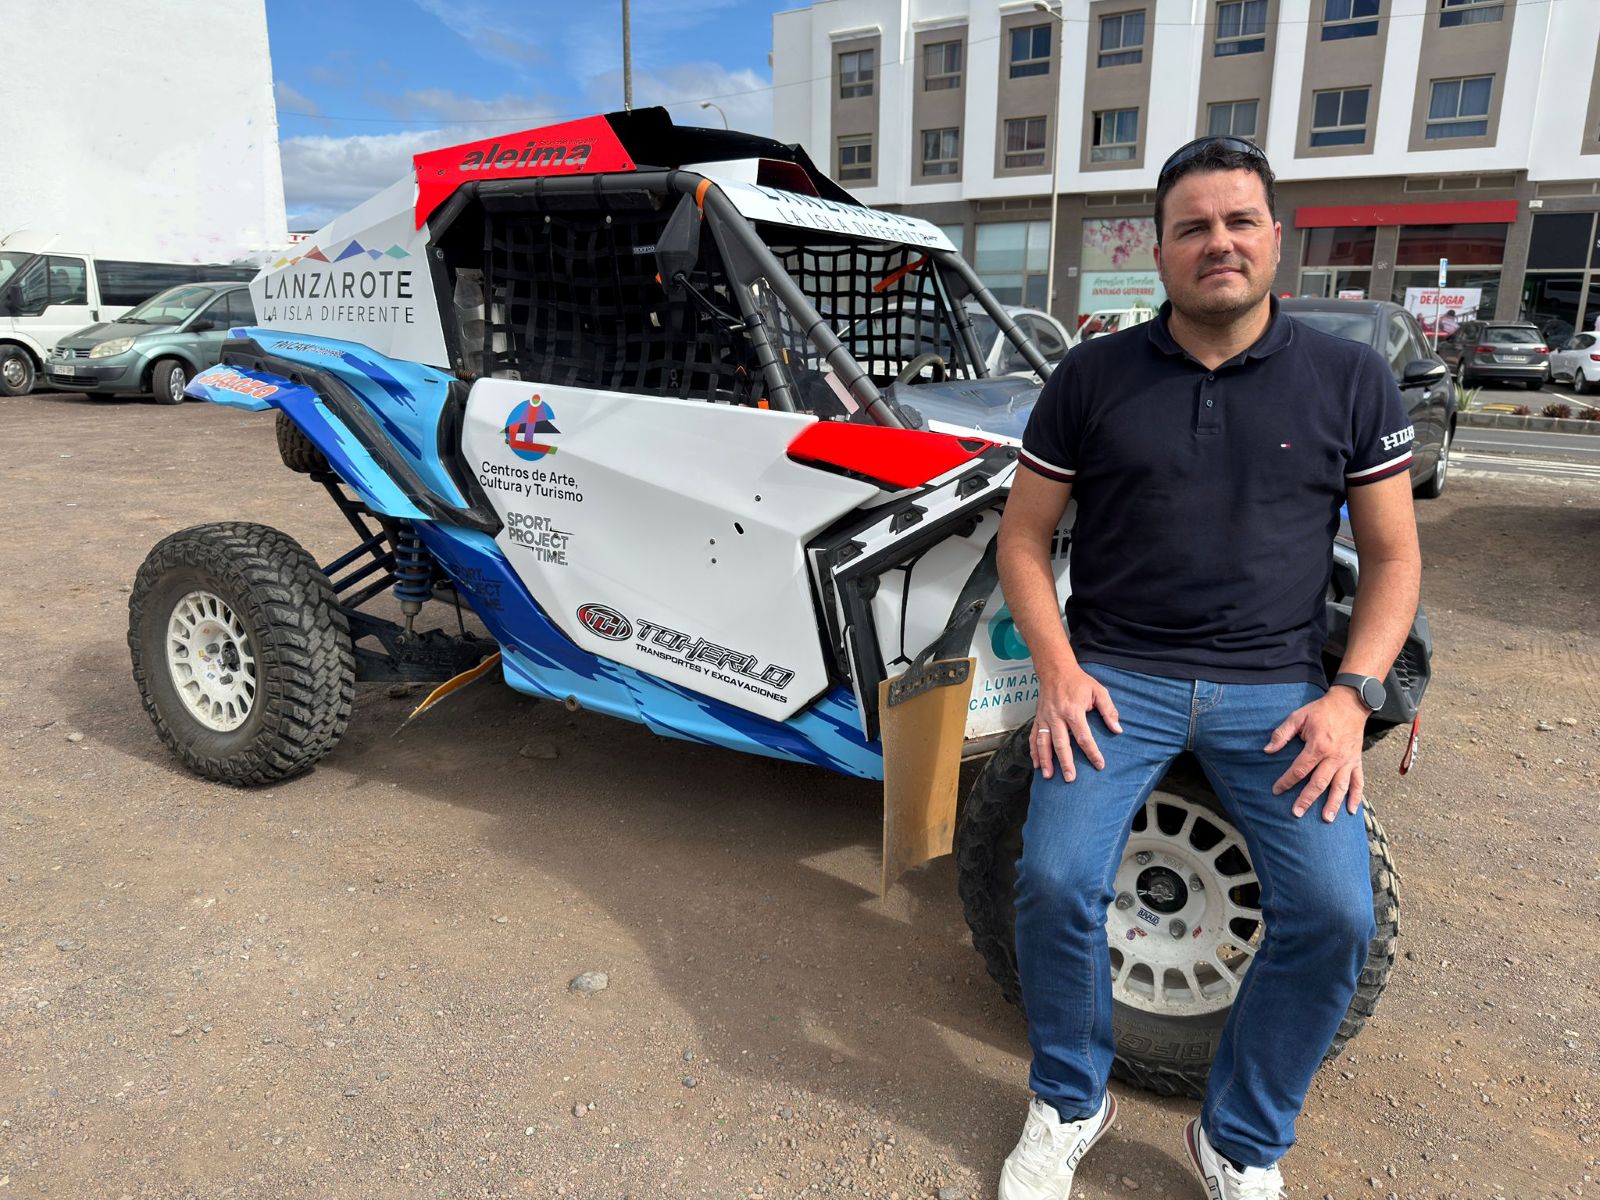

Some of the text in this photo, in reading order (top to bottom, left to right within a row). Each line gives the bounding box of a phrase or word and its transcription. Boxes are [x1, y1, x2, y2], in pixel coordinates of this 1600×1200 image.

[459, 142, 593, 171] aleima
[777, 206, 805, 225] LA
[808, 213, 852, 233] ISLA
[264, 270, 413, 299] LANZAROTE
[1420, 295, 1465, 305] DE HOGAR
[263, 305, 415, 323] LA ISLA DIFERENTE
[481, 461, 578, 489] Centros de Arte,
[479, 475, 583, 503] Cultura y Turismo
[507, 511, 552, 532] SPORT
[508, 527, 569, 550] PROJECT
[635, 643, 702, 673] TRANSPORTES
[711, 671, 788, 704] EXCAVACIONES
[985, 672, 1040, 692] LUMAR
[969, 687, 1040, 711] CANARIA
